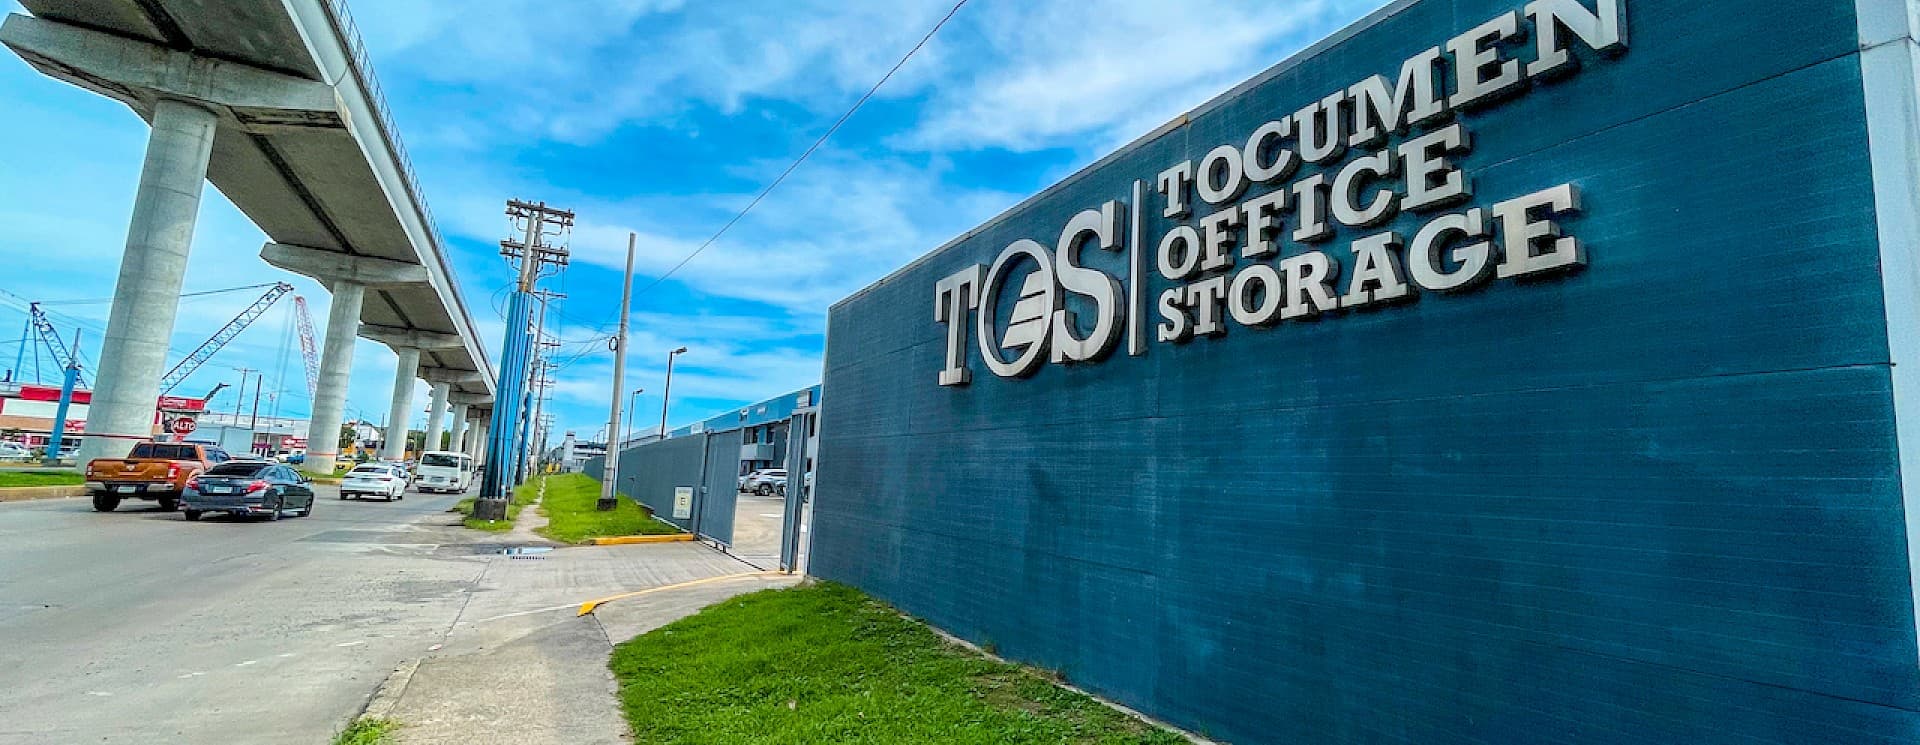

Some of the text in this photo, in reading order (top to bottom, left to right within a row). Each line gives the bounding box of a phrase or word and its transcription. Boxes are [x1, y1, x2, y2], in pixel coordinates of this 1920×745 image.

[1157, 0, 1627, 217] TOCUMEN
[1157, 122, 1472, 281] OFFICE
[1157, 183, 1587, 344] STORAGE
[935, 199, 1126, 386] TOS
[173, 419, 197, 432] ALTO
